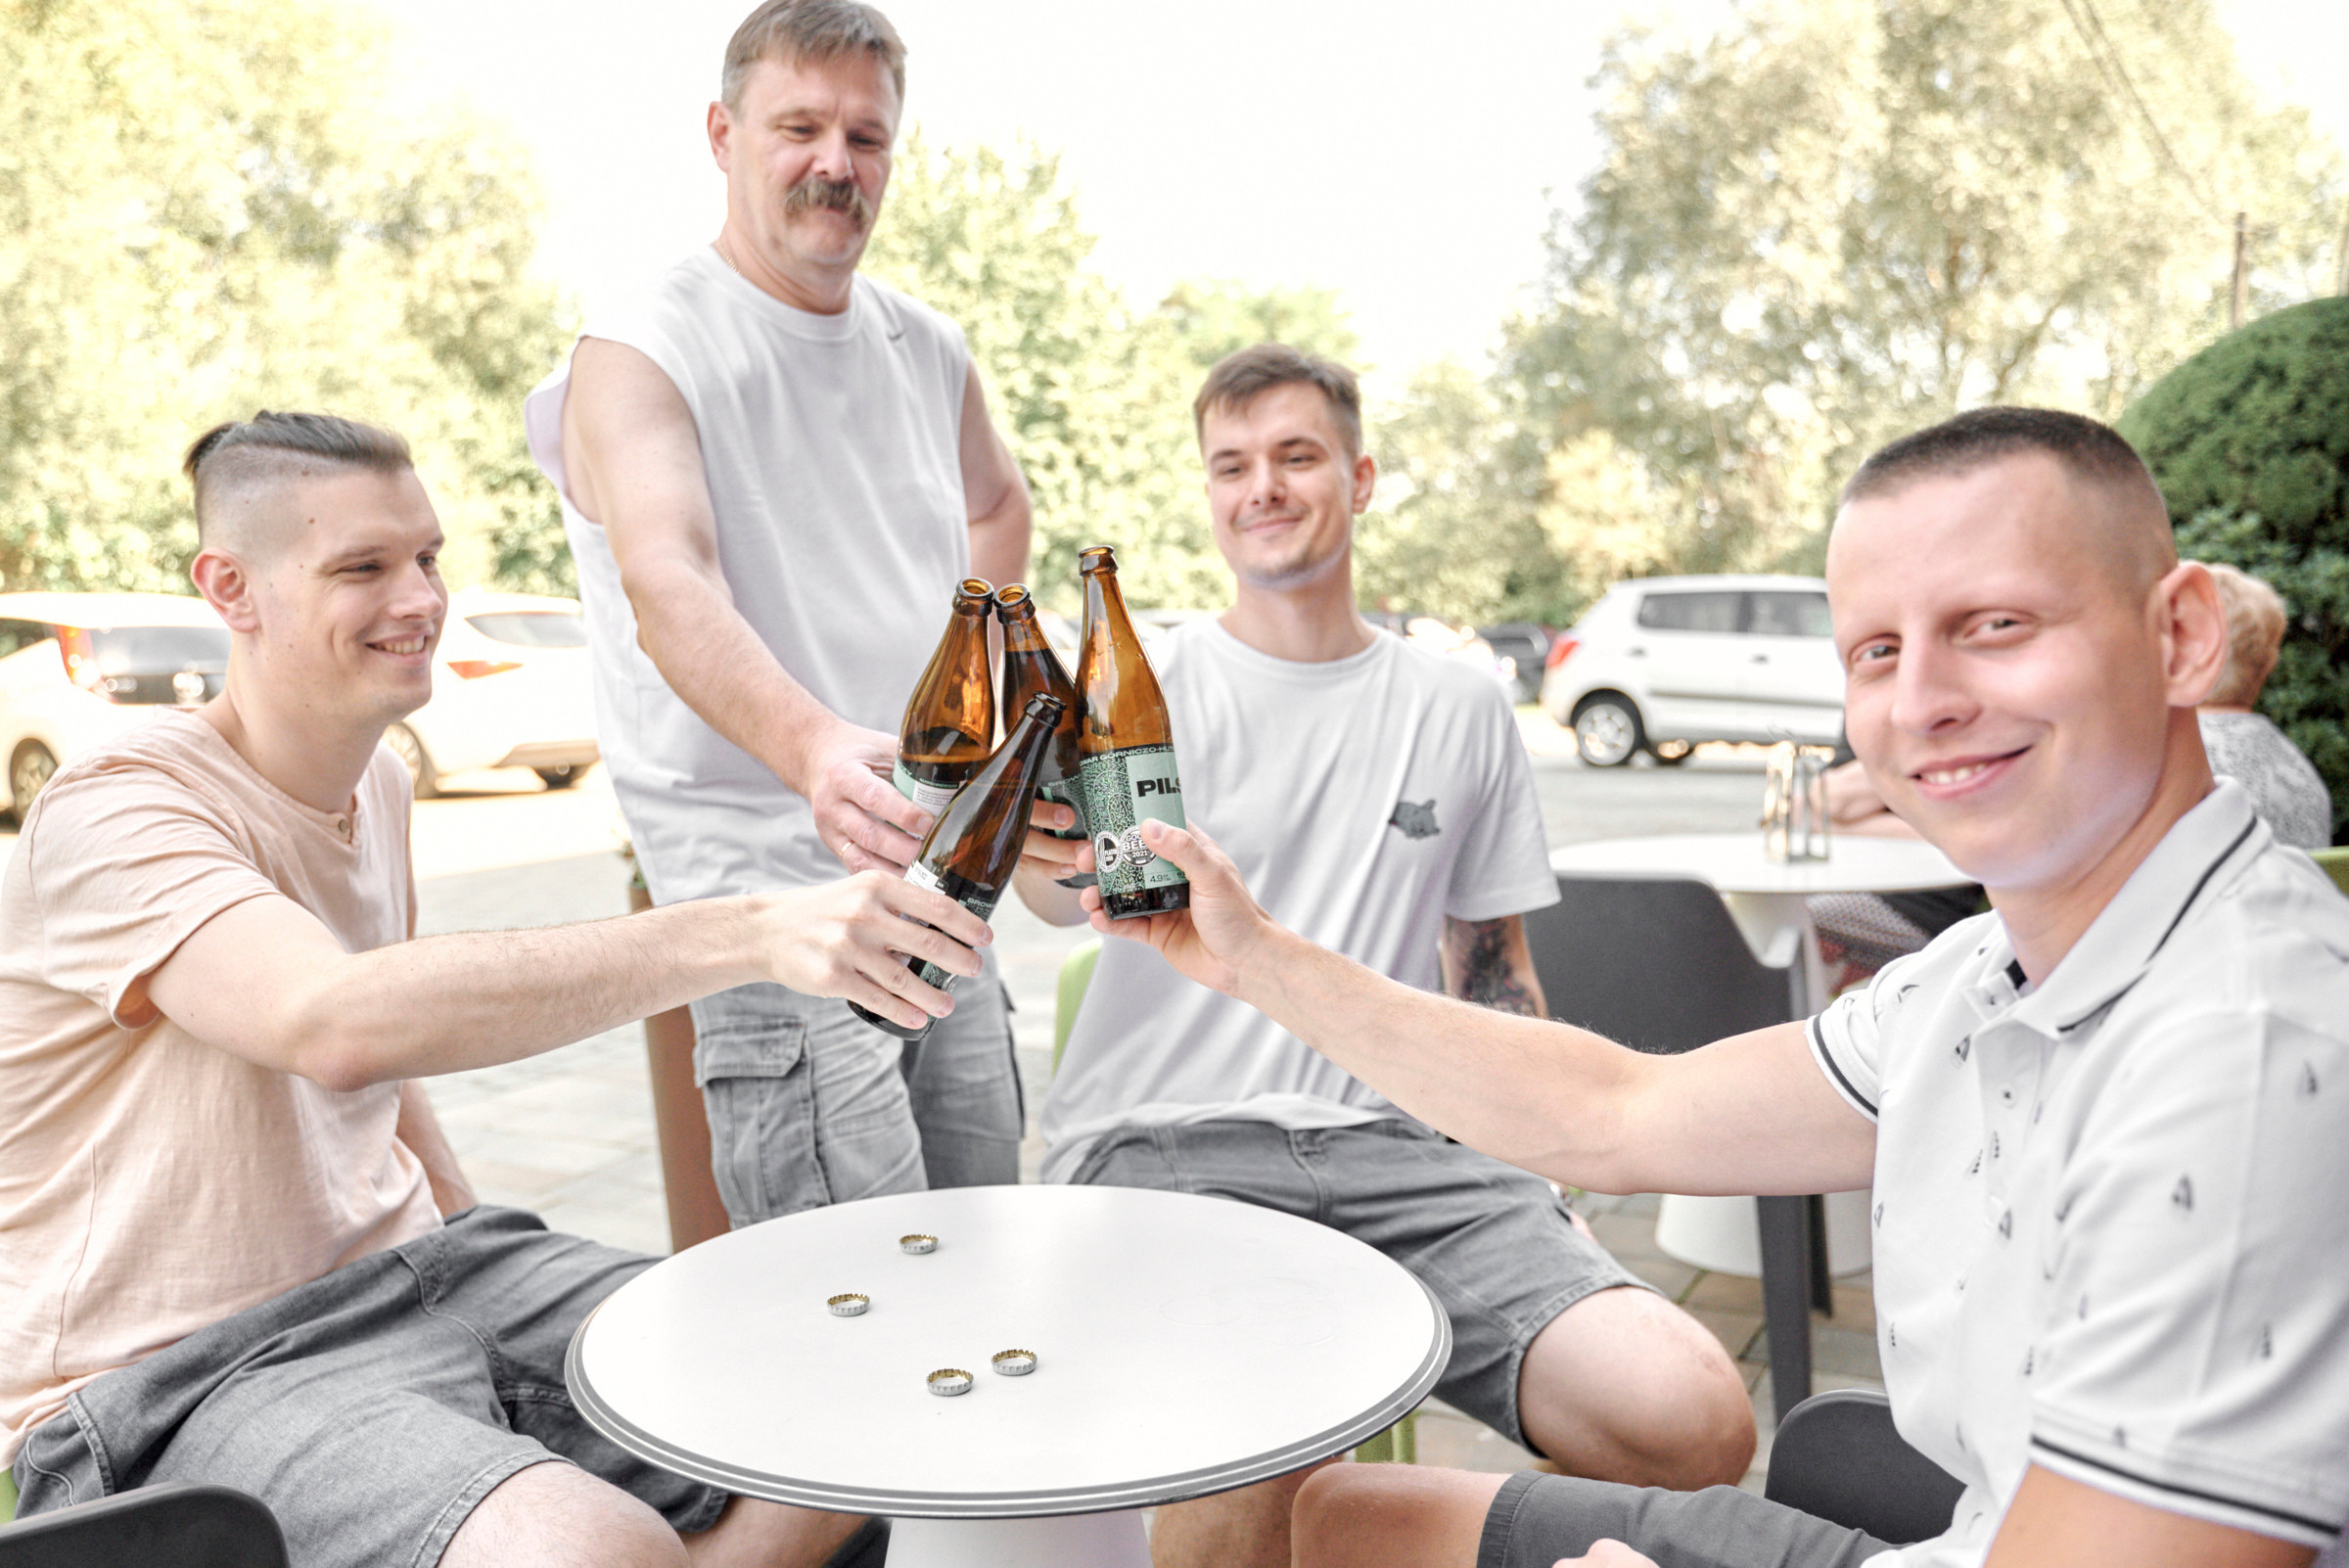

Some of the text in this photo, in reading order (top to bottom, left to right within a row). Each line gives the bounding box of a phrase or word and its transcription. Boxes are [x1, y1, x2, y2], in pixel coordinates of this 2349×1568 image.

[1099, 745, 1174, 761] GÓRNICZO-HUT
[1131, 850, 1148, 858] 2021
[967, 897, 994, 909] BROW
